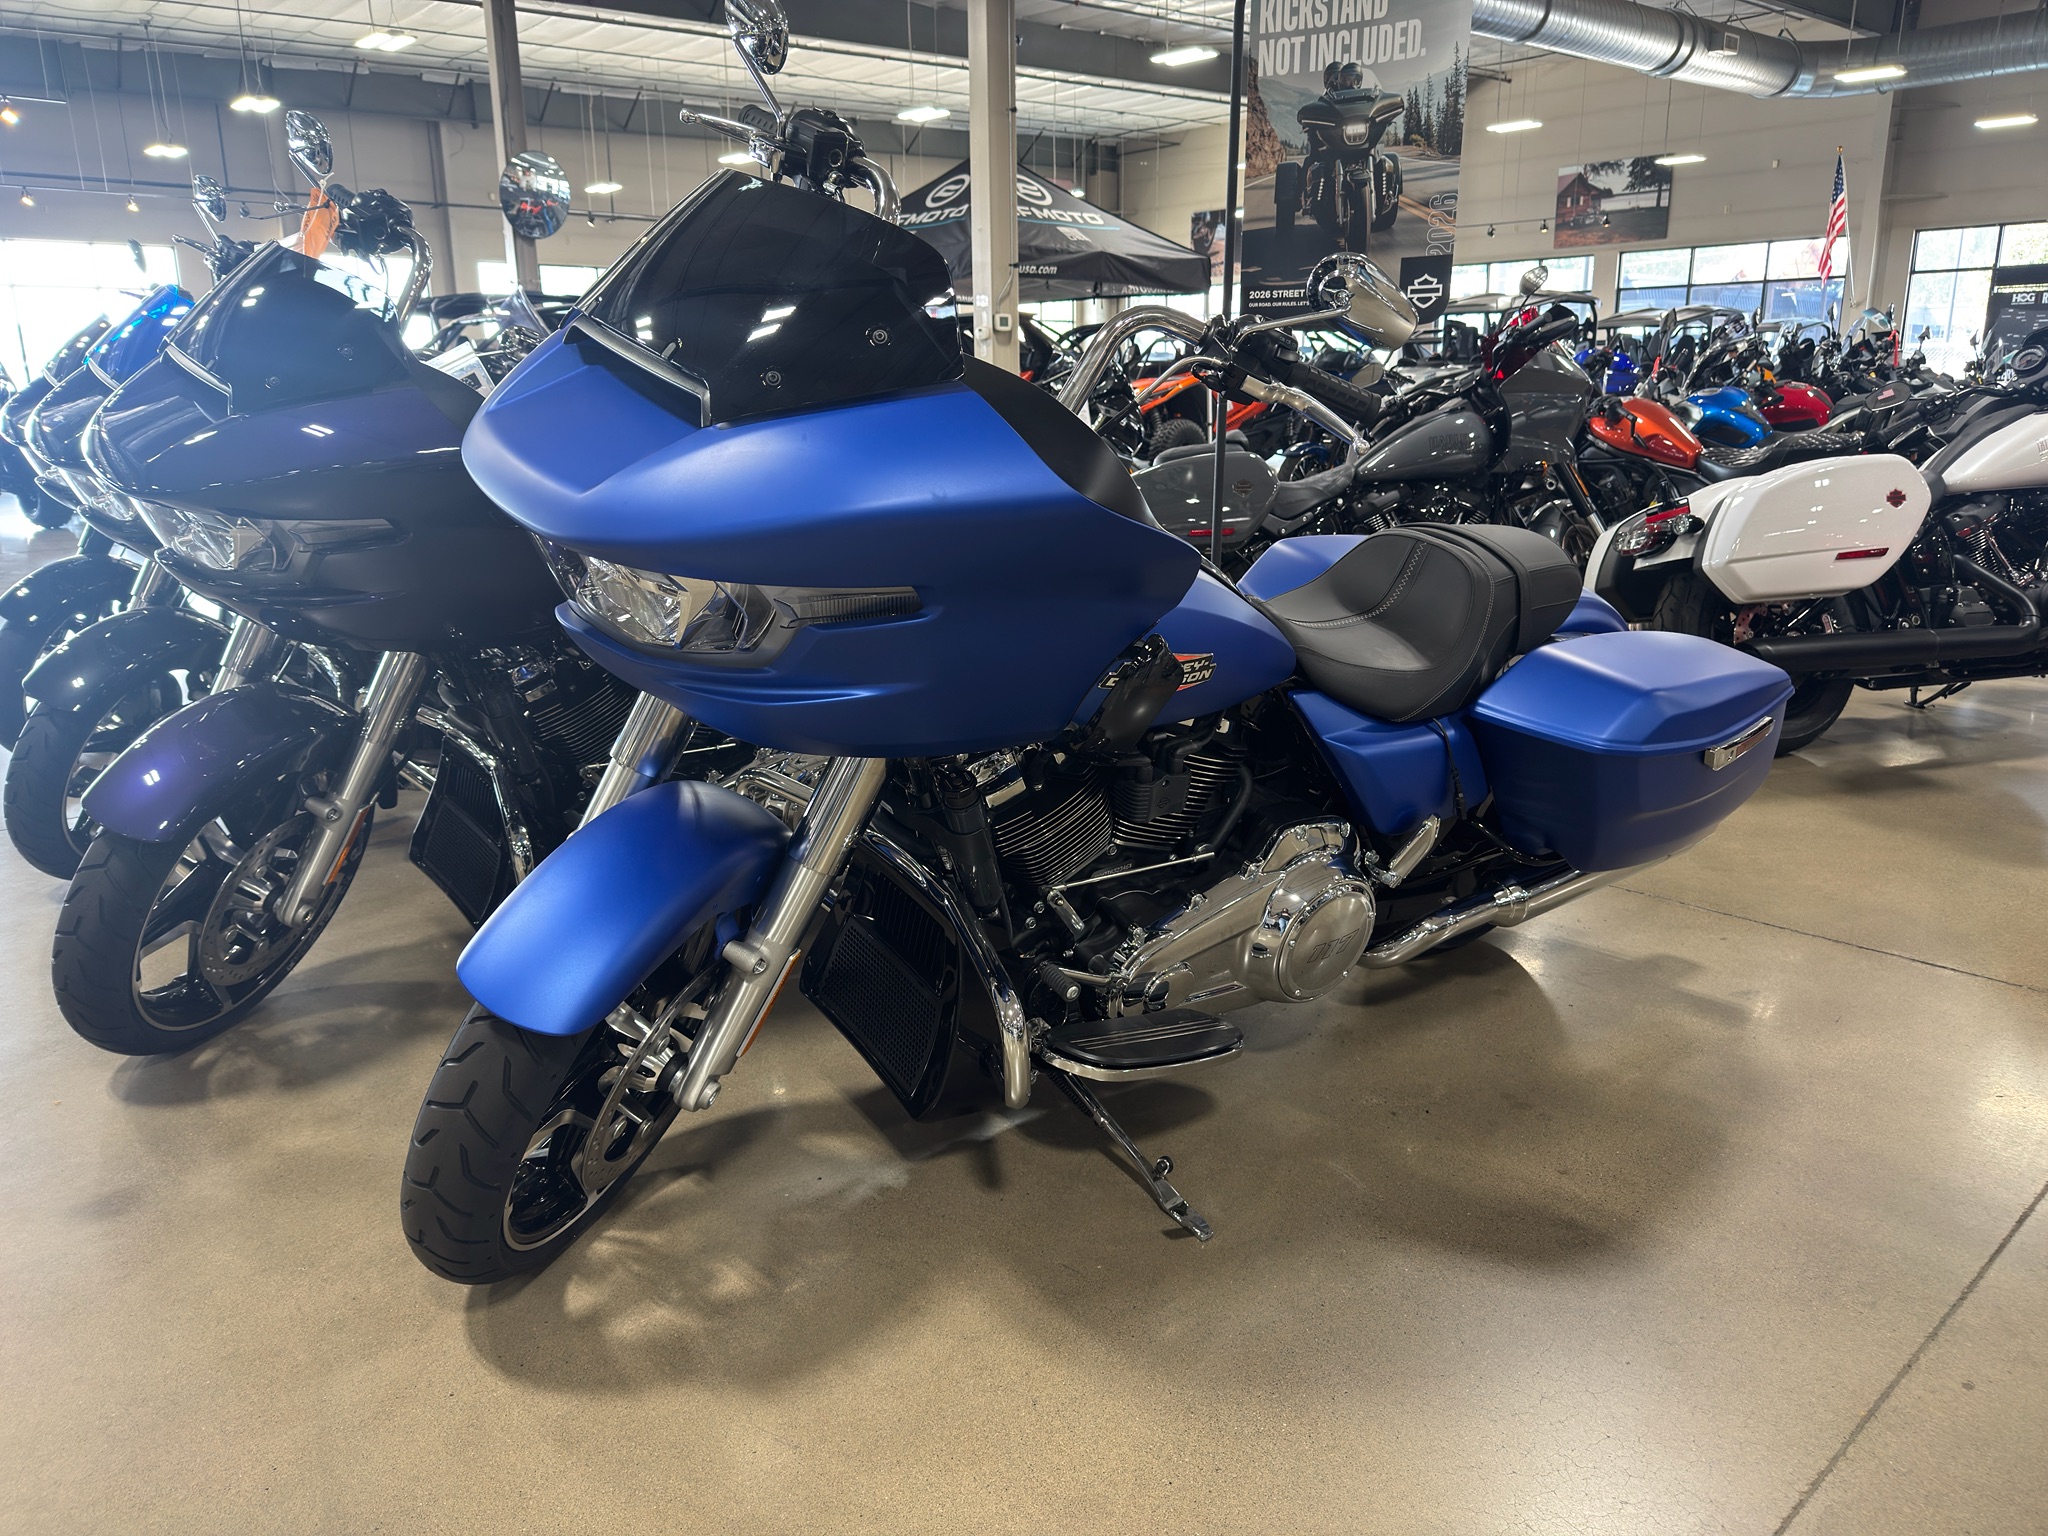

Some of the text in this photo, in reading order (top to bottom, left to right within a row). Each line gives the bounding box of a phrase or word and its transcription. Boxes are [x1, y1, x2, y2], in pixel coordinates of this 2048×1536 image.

[1259, 0, 1389, 34] KICKSTAND
[1258, 18, 1427, 77] NOT INCLUDED.
[899, 203, 970, 226] FMOTO
[1017, 205, 1105, 225] FMOTO
[1425, 192, 1459, 256] 2026
[1018, 264, 1058, 275] usa.com
[1249, 290, 1305, 299] 2026 STREET
[1306, 928, 1360, 964] 117
